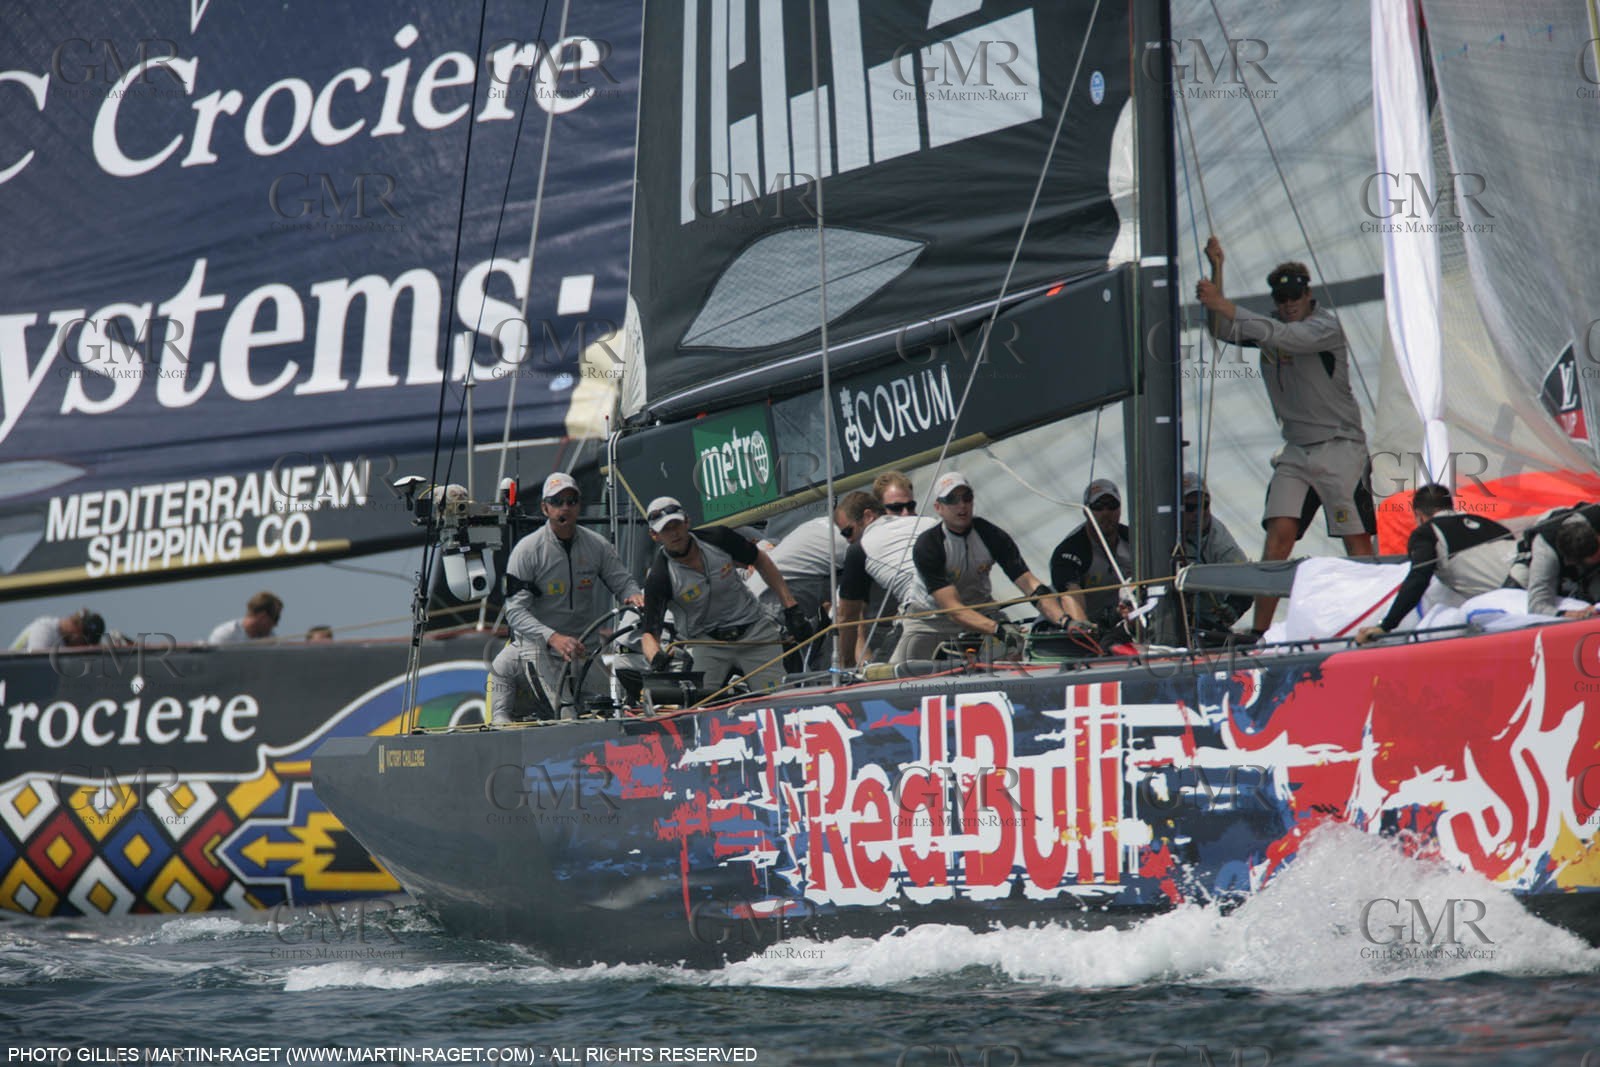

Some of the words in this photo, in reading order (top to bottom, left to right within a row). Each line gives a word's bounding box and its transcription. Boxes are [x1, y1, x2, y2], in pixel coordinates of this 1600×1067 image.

[93, 24, 601, 177] Crociere
[853, 364, 956, 449] CORUM
[46, 459, 371, 542] MEDITERRANEAN
[86, 519, 242, 577] SHIPPING
[256, 513, 318, 556] CO.
